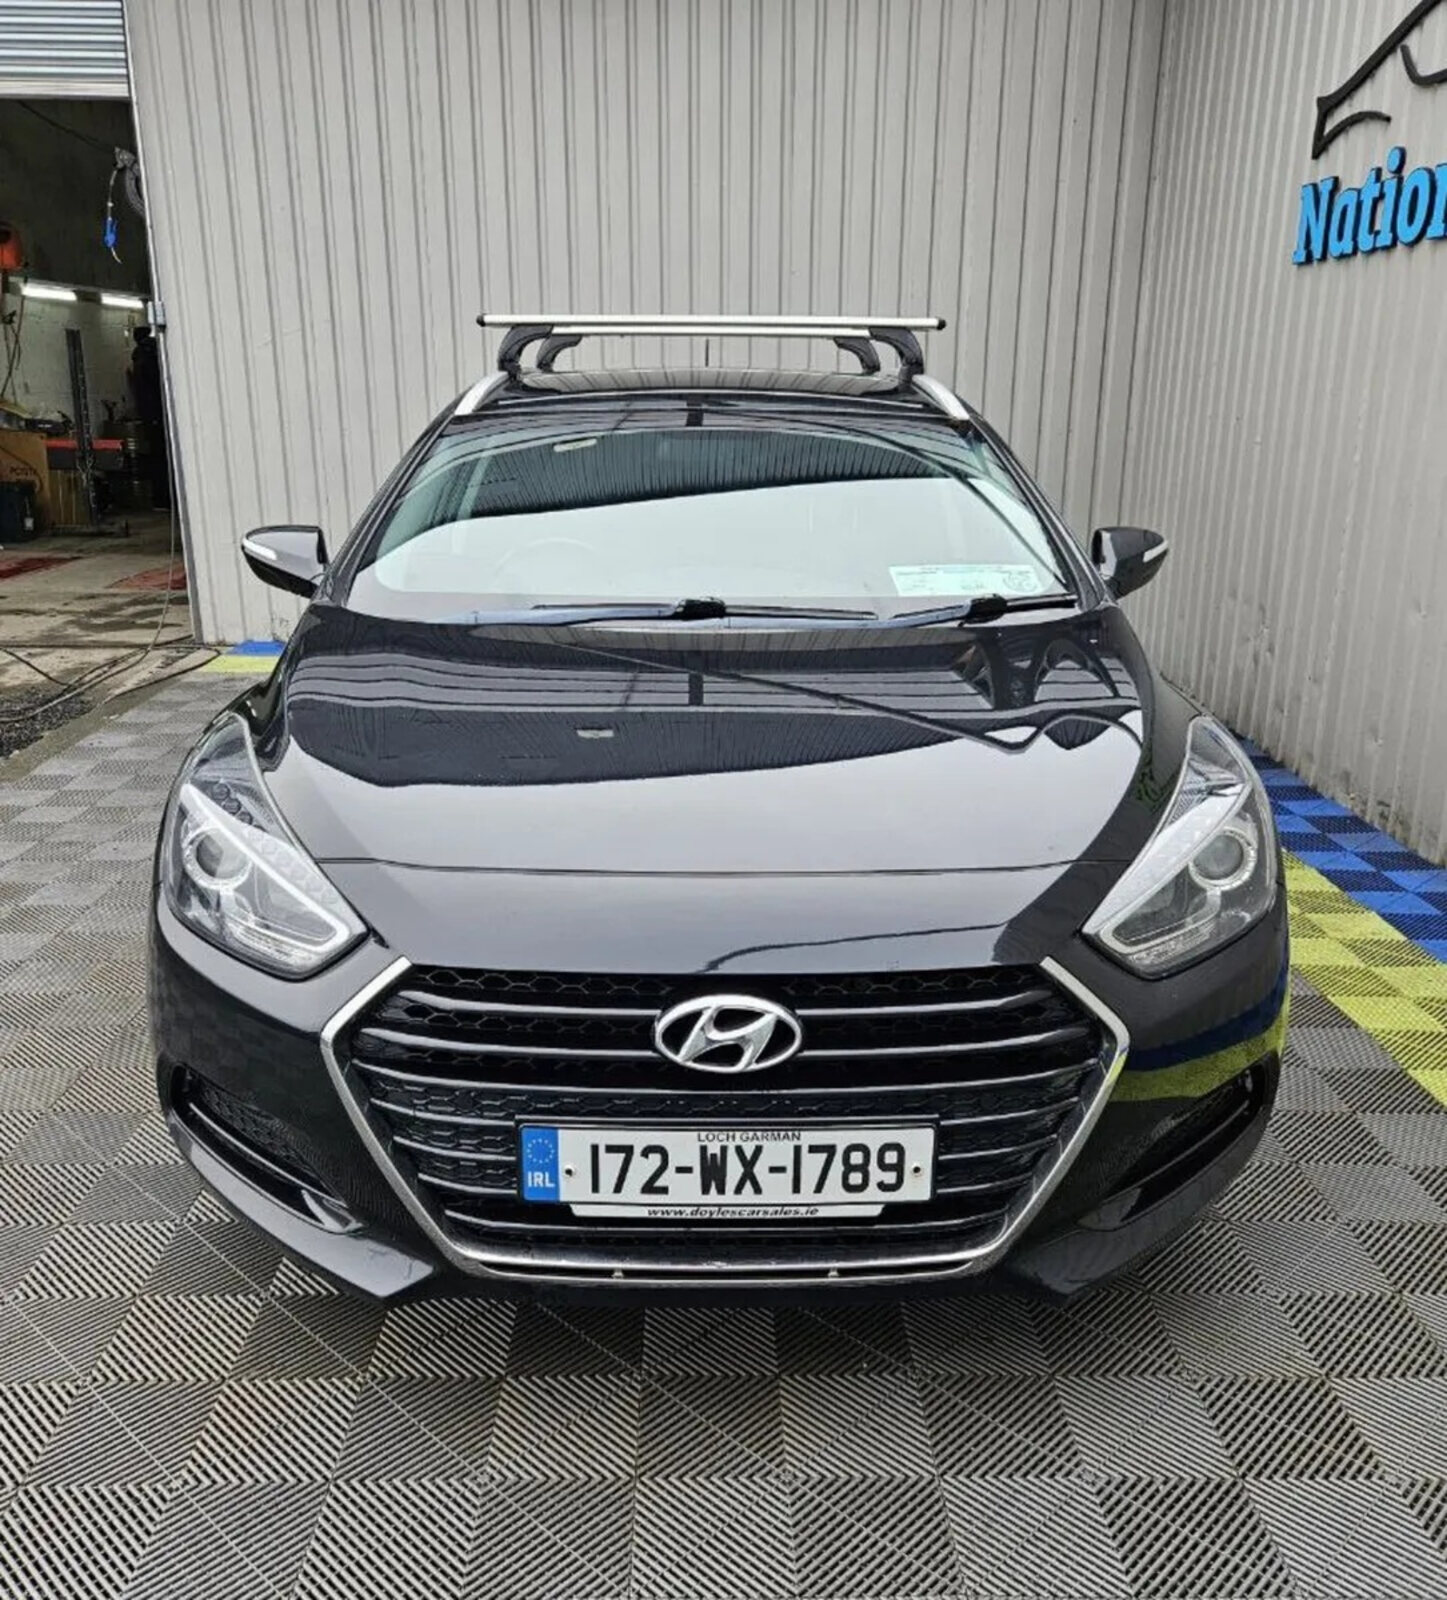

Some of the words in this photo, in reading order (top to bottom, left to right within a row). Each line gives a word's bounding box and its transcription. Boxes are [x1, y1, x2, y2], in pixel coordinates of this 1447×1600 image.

[697, 1132, 736, 1143] LOCH
[739, 1131, 801, 1143] GARMAN
[590, 1142, 906, 1196] 172-WX-1789
[527, 1171, 555, 1188] IRL
[647, 1207, 819, 1219] www.doylescarsales.ie
